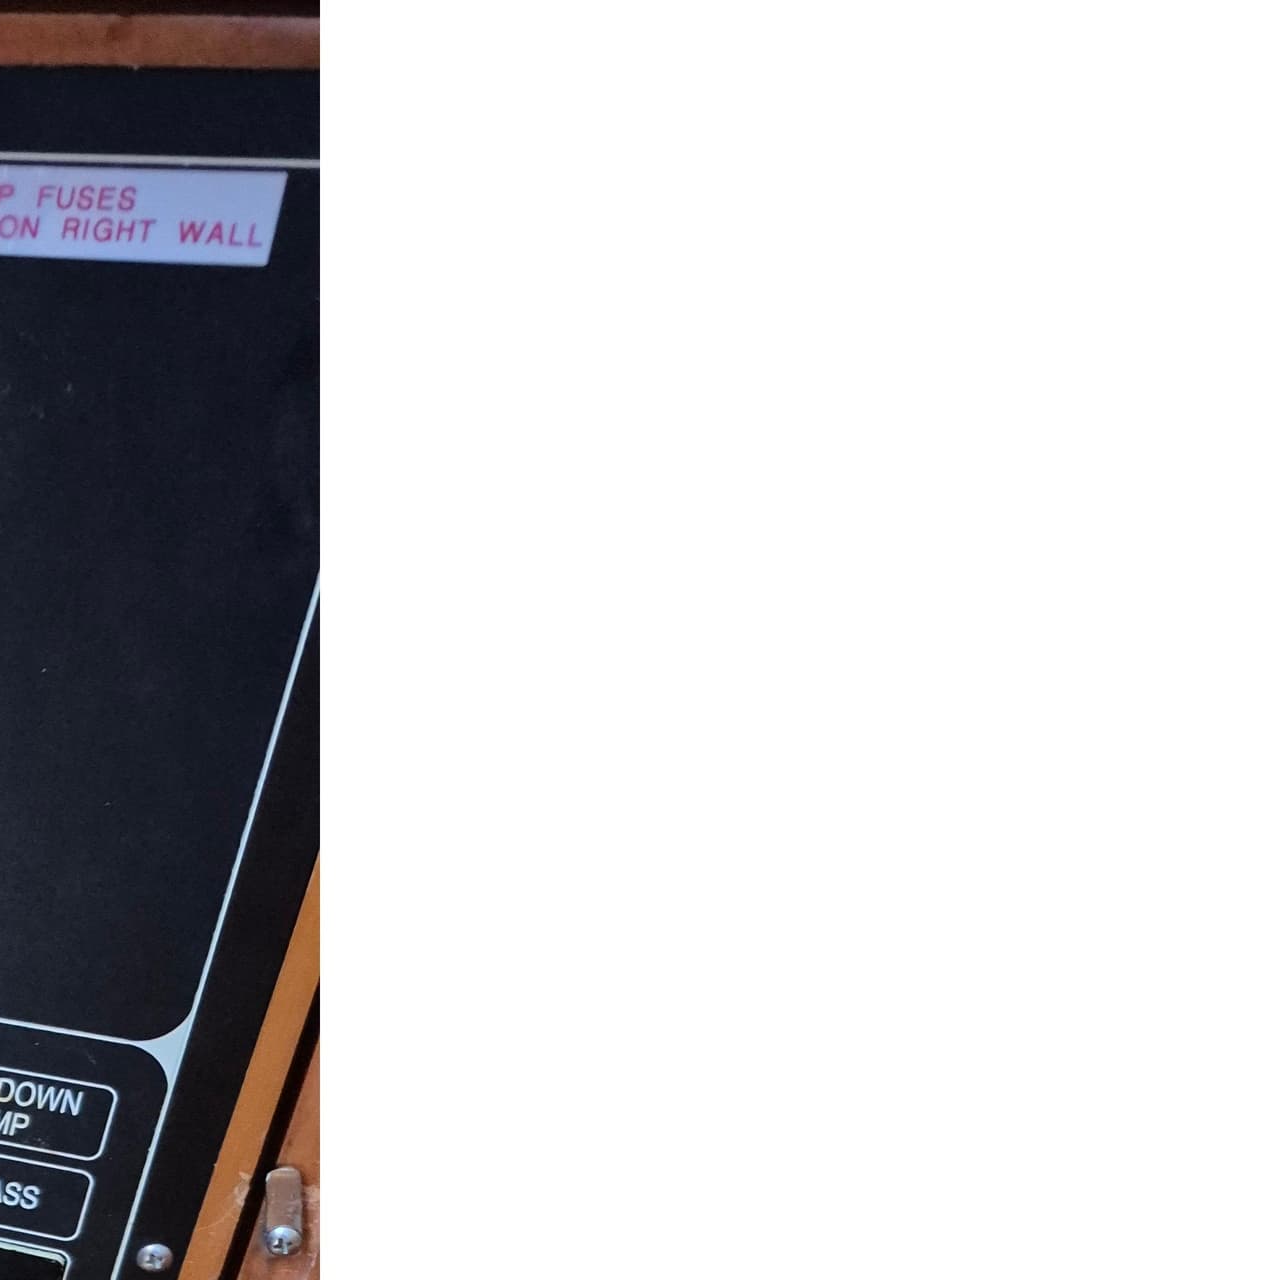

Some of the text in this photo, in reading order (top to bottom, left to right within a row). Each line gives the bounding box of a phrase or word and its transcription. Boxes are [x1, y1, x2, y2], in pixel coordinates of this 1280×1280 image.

[39, 185, 137, 212] FUSES
[62, 216, 156, 244] RIGHT
[180, 221, 263, 249] WALL
